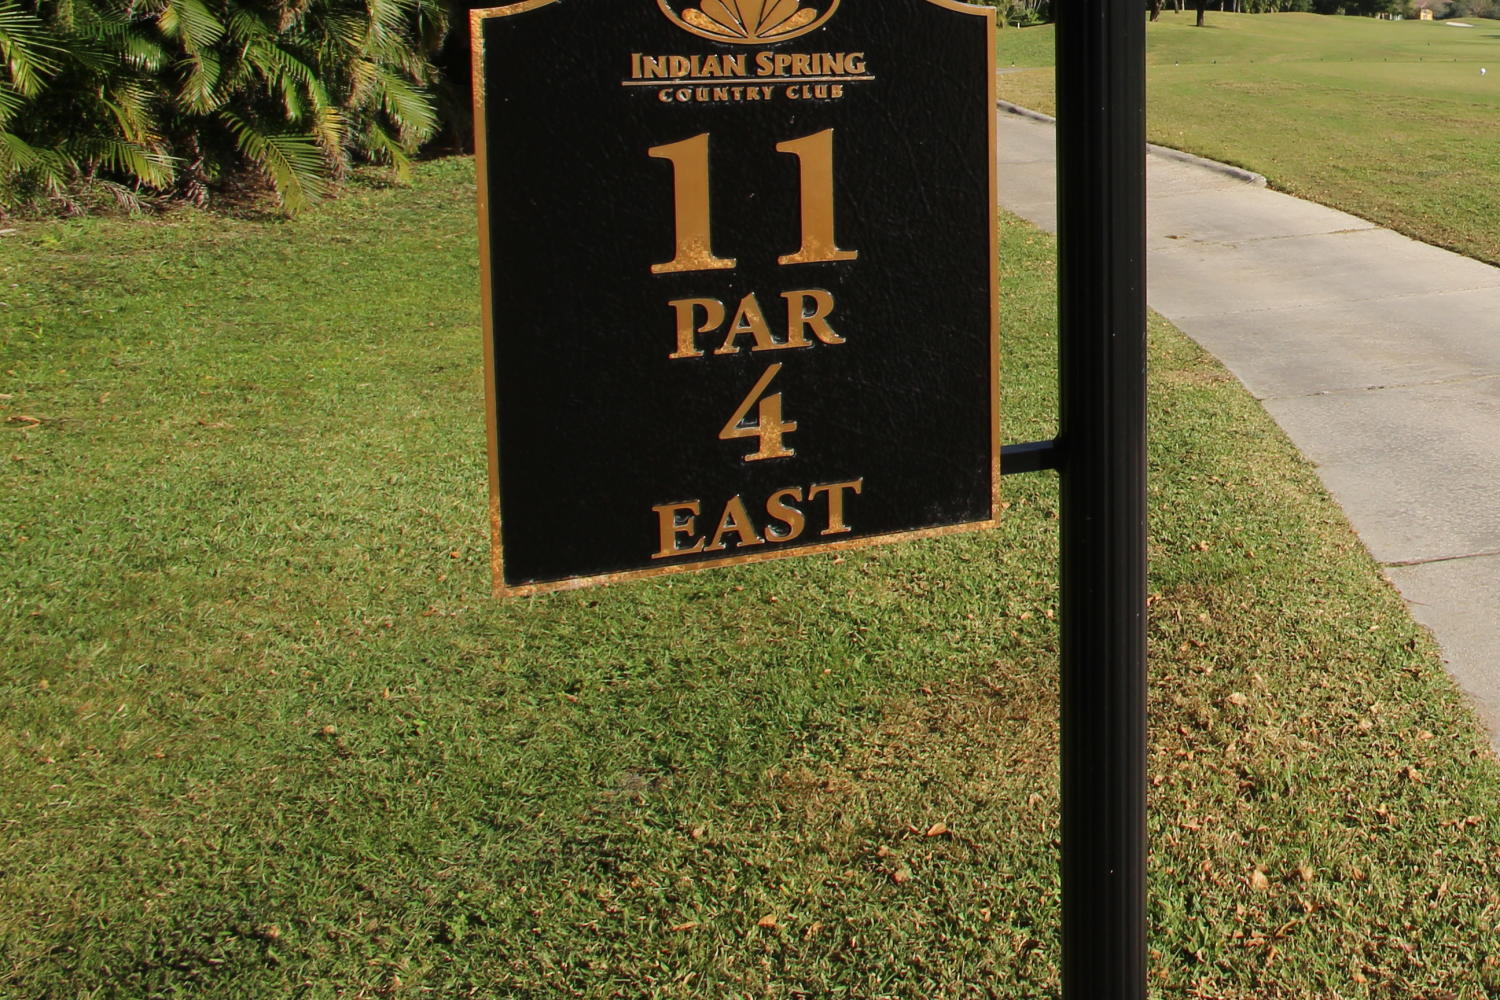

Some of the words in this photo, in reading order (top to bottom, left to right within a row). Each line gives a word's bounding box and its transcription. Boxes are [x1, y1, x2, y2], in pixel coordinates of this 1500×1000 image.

[658, 86, 775, 103] COUNTRY
[786, 84, 844, 100] CLUB
[668, 289, 846, 359] PAR
[718, 362, 797, 462] 4
[651, 477, 863, 559] EAST
